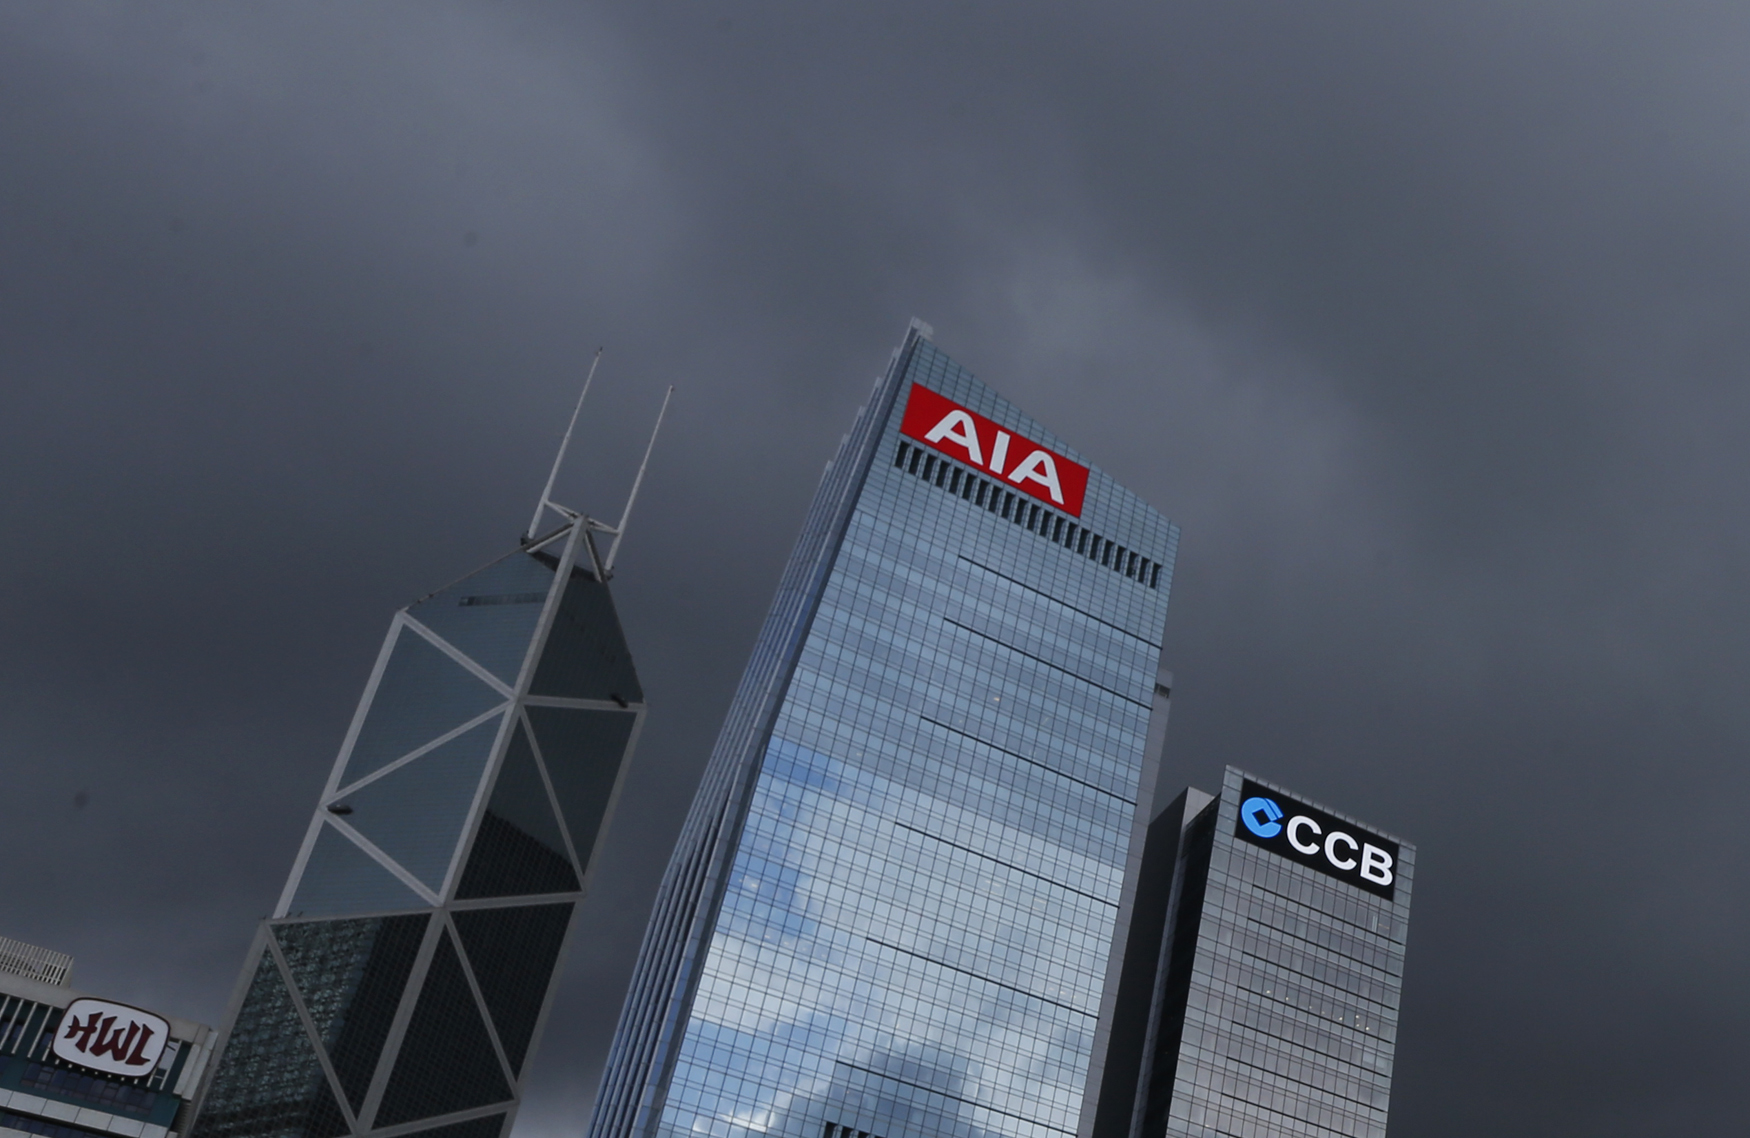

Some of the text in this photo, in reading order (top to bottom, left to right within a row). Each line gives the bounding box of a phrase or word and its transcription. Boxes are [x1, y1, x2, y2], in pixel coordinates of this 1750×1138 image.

[924, 409, 1064, 505] AIA
[1286, 815, 1394, 886] CCB
[64, 1011, 155, 1066] HWL
